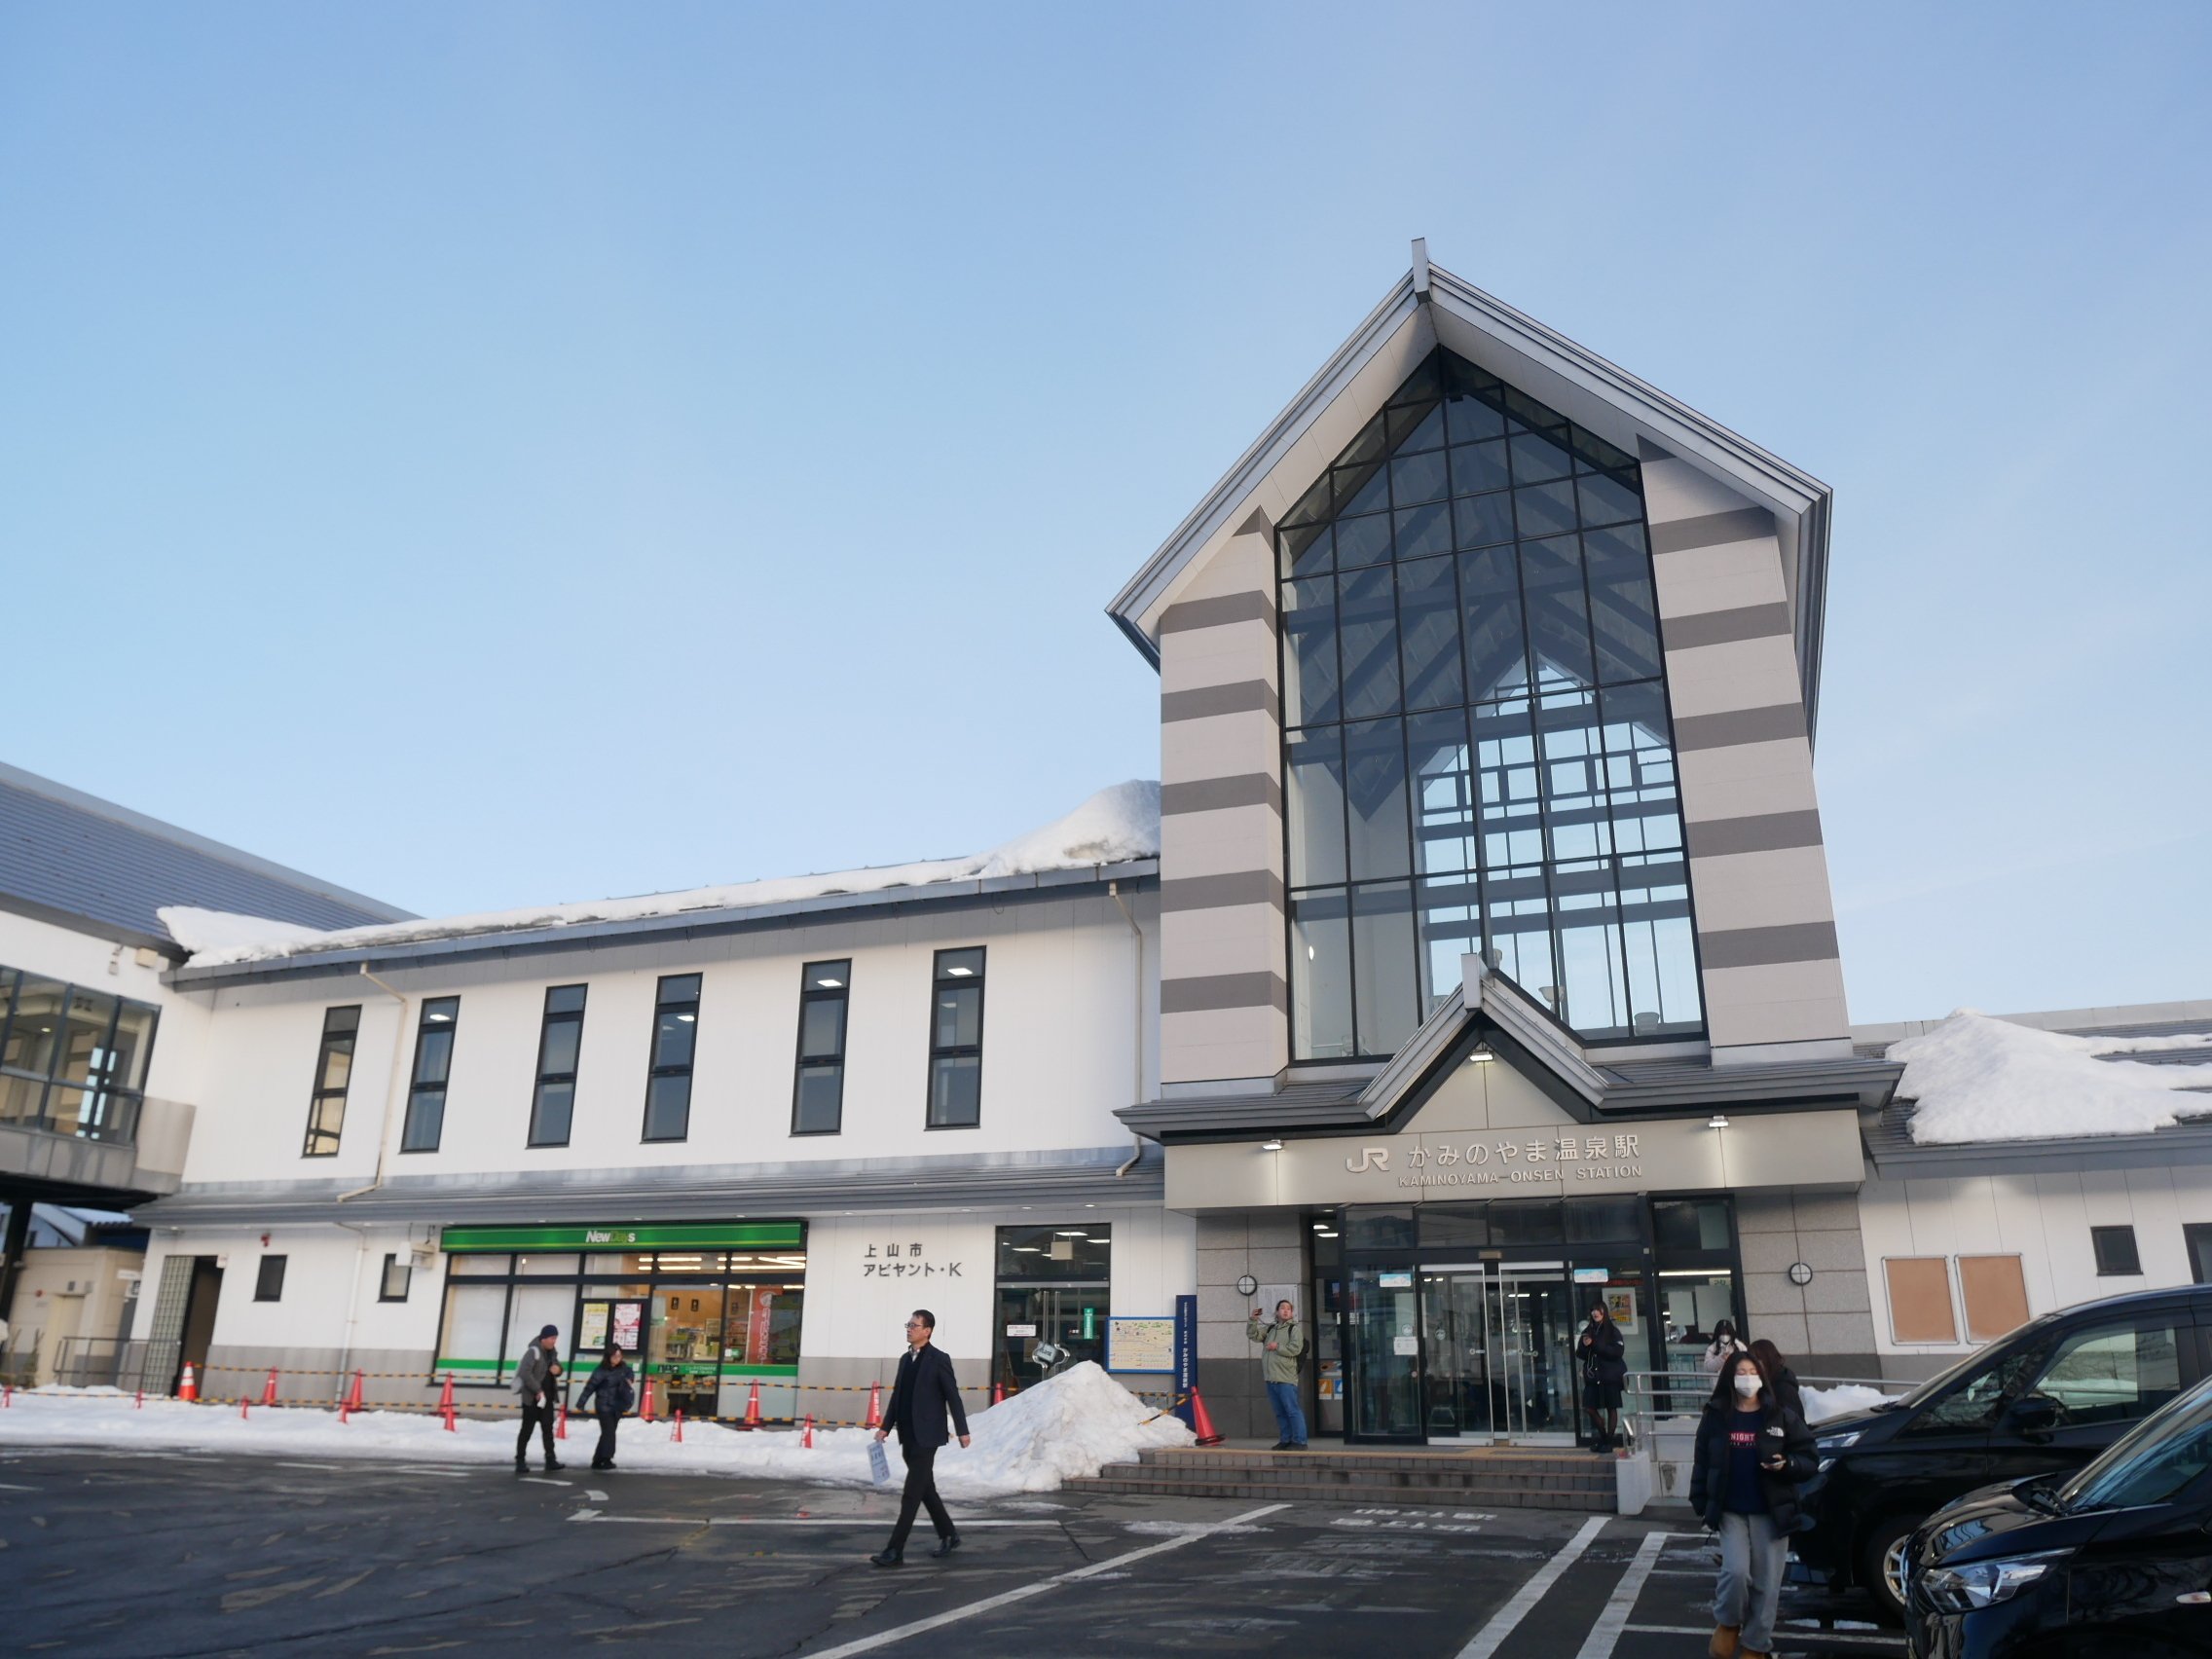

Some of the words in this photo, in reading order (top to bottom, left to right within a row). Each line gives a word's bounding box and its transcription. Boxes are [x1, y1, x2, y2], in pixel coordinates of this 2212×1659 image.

[1408, 1133, 1641, 1168] かみのやま温泉駅
[1346, 1148, 1390, 1173] JR
[1576, 1164, 1642, 1181] STATION
[864, 1242, 922, 1258] 上山市
[864, 1262, 963, 1277] アビヤント・K
